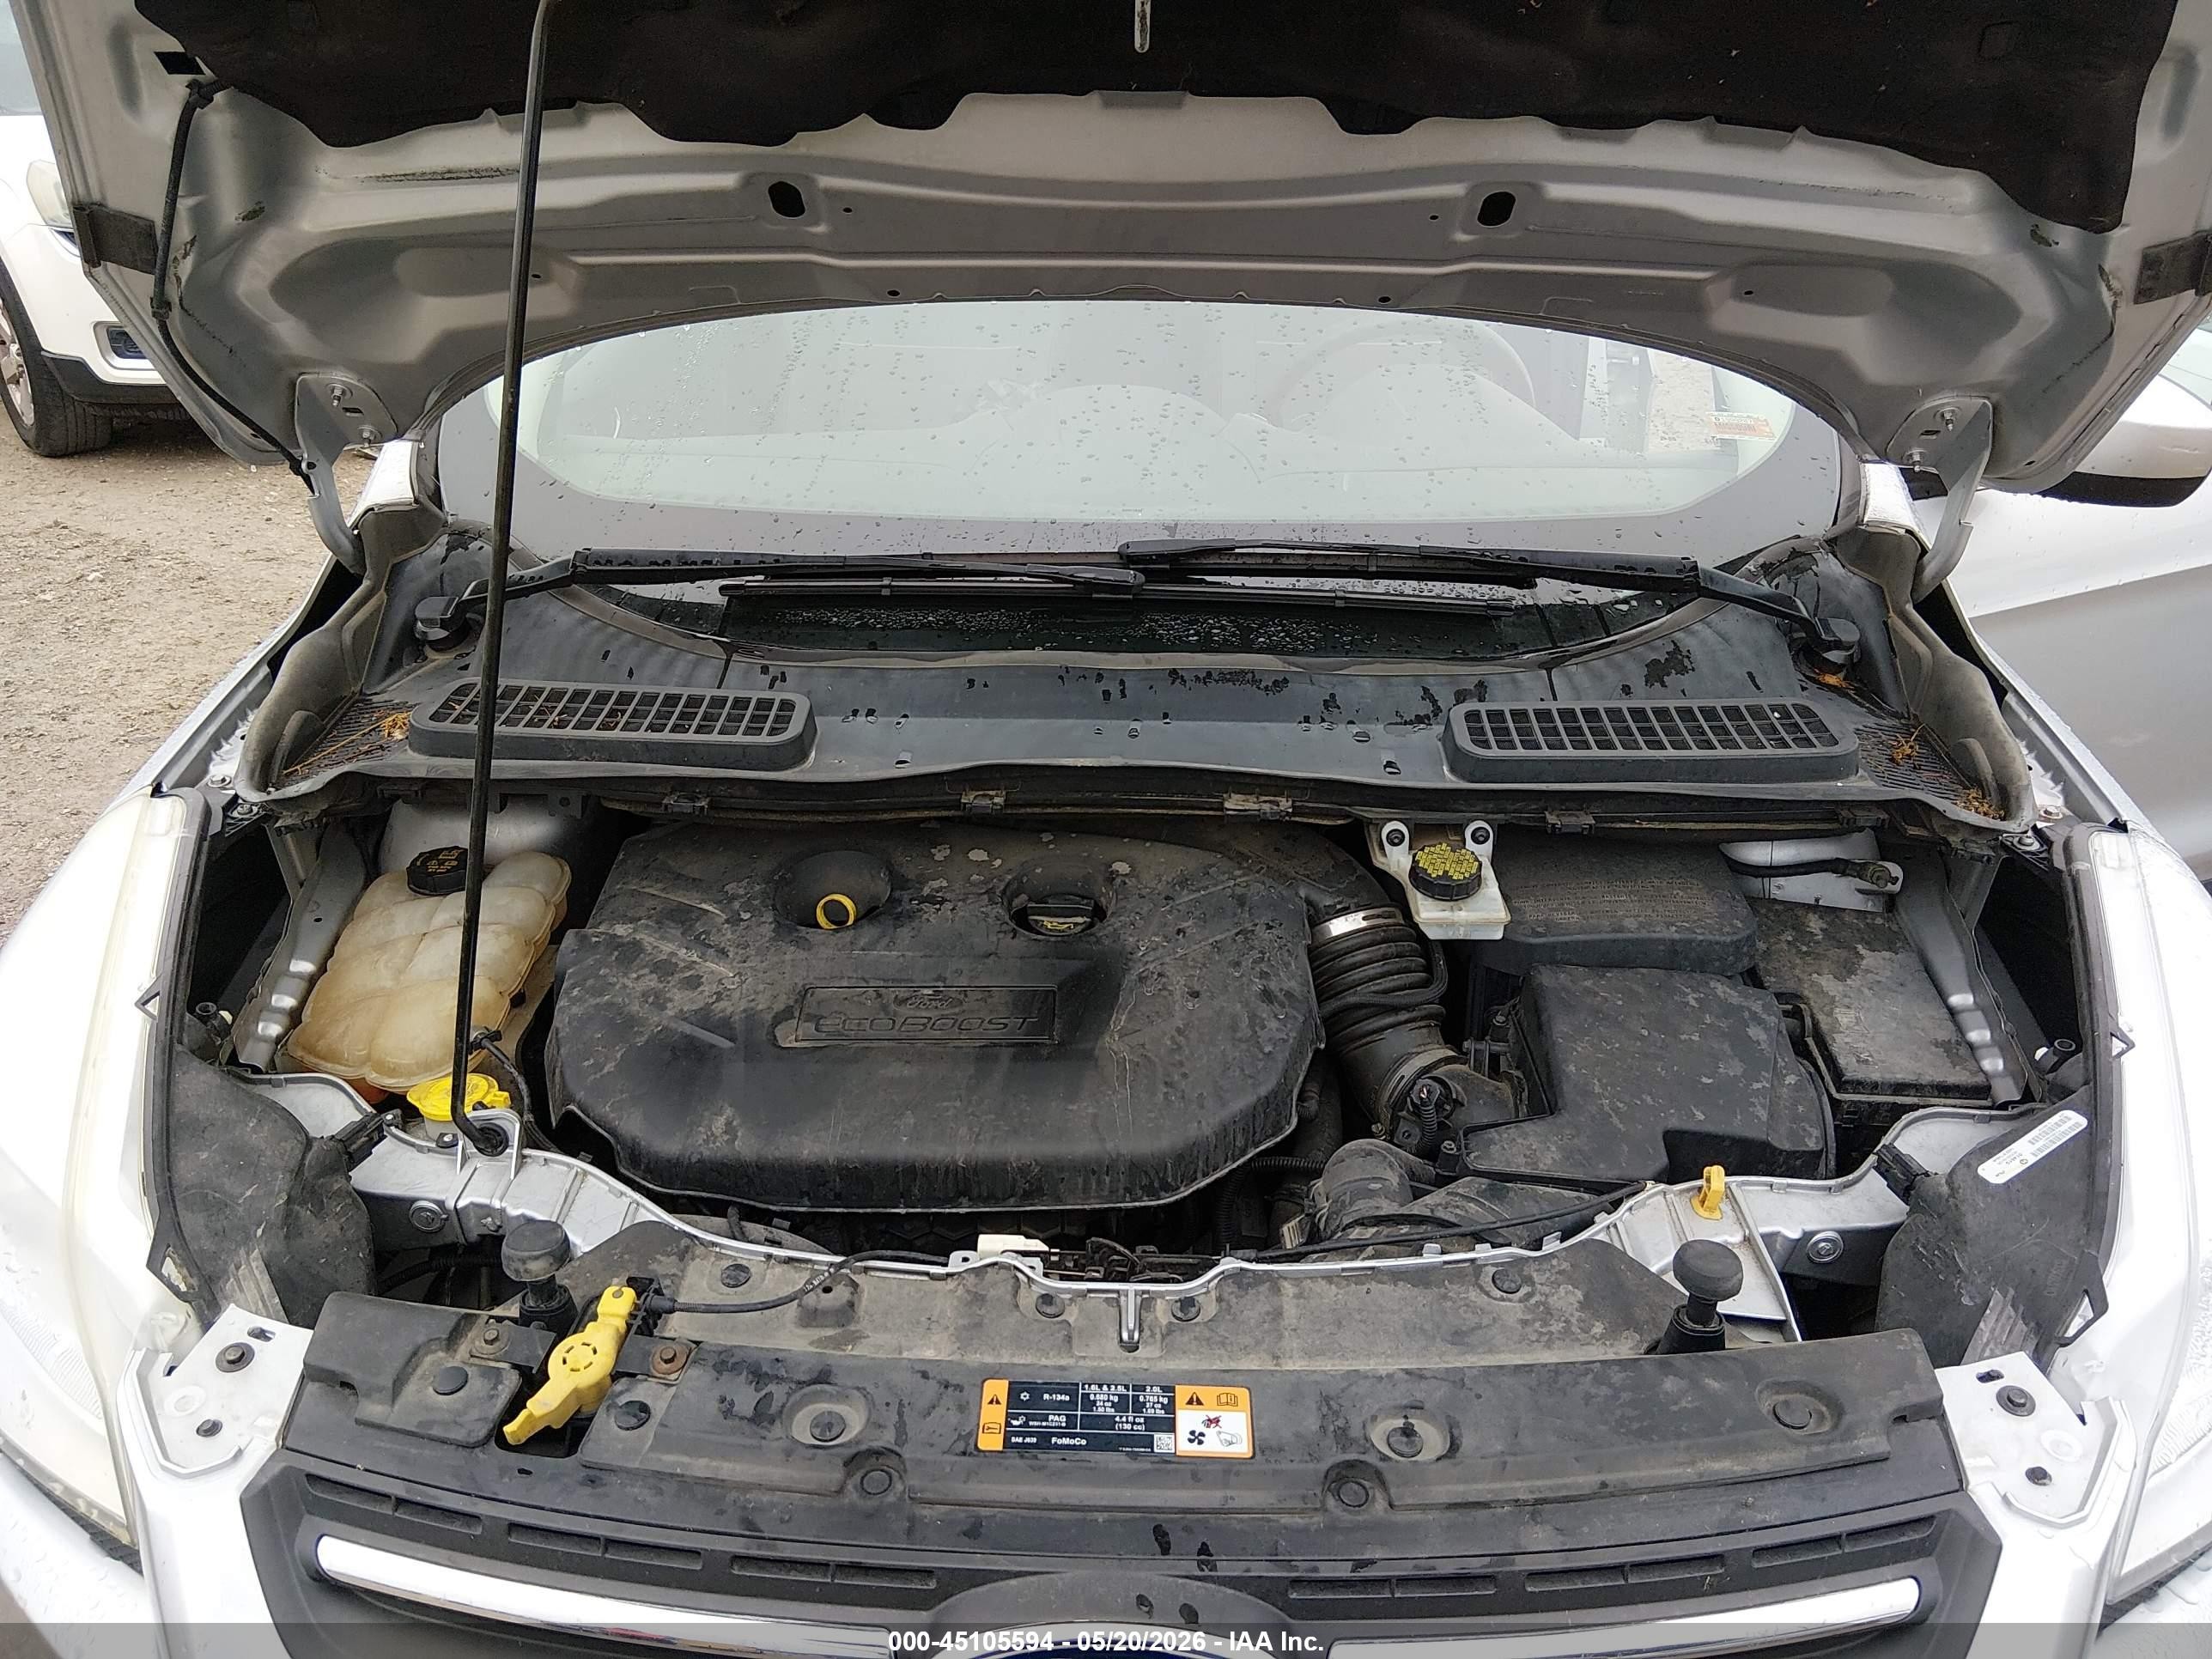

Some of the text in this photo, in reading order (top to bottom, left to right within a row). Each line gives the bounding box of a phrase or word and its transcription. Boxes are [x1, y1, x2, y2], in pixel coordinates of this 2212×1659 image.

[907, 996, 952, 1010] Ford
[1043, 1393, 1070, 1401] R-134a
[1158, 1395, 1169, 1404] kg
